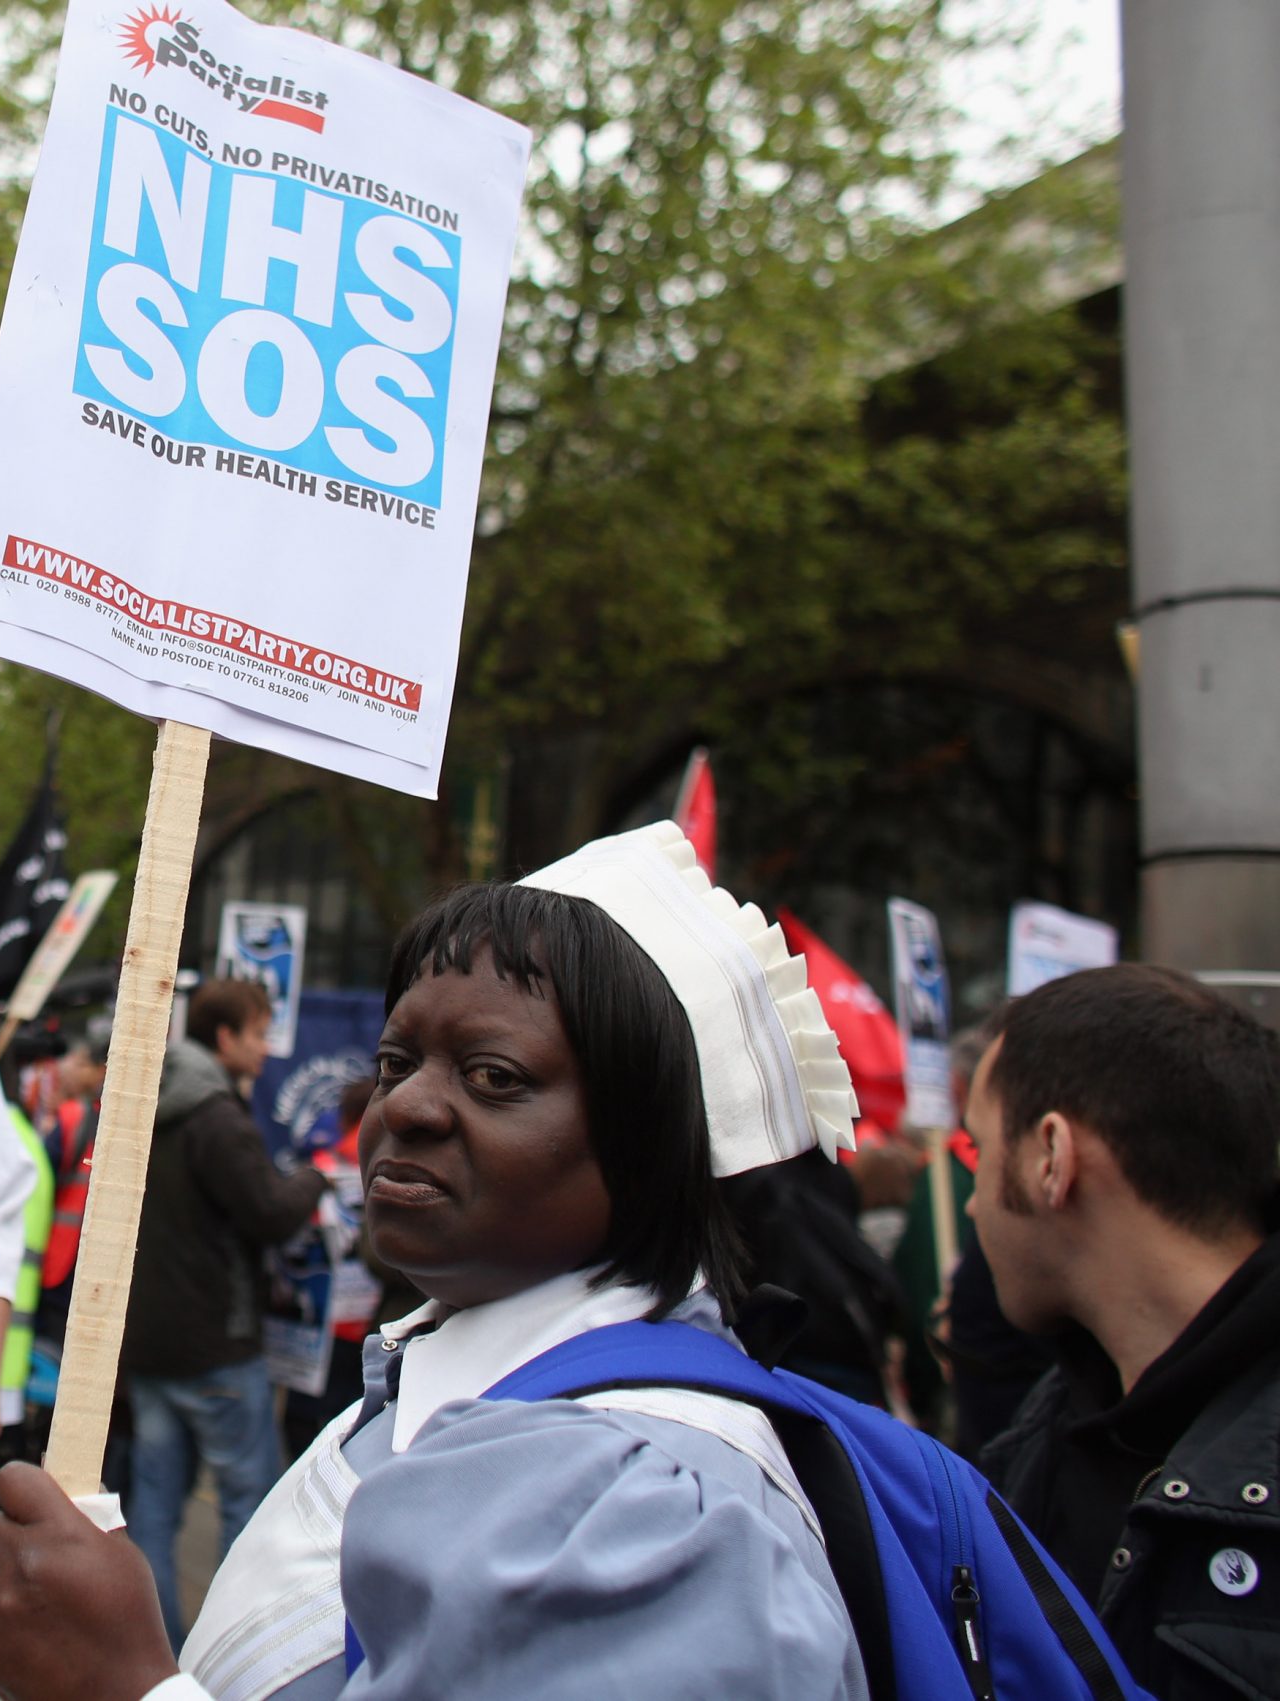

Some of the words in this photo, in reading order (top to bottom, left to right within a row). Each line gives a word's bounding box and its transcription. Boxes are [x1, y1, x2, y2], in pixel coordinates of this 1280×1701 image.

[155, 37, 263, 112] Party
[172, 22, 329, 110] Socialist
[109, 83, 147, 114] NO
[154, 104, 213, 160] CUTS,
[222, 143, 262, 167] NO
[272, 152, 459, 232] PRIVATISATION
[103, 115, 454, 355] NHS
[84, 262, 435, 487] SOS
[81, 402, 147, 449] SAVE
[151, 434, 207, 468] OUR
[215, 449, 318, 497] HEALTH
[324, 480, 436, 530] SERVICE
[0, 568, 30, 586] CALL
[36, 578, 59, 594] 020
[63, 588, 91, 608] 8988
[126, 619, 155, 641] EMAIL
[337, 689, 360, 705] JOIN
[363, 694, 386, 713] AND
[389, 707, 418, 724] YOUR
[15, 541, 409, 704] WWW.SOCIALISTPARTY.ORG.UK
[111, 627, 135, 649] NAME
[136, 642, 159, 657] AND
[161, 644, 214, 671] POSTODE
[217, 663, 231, 676] TO
[233, 670, 266, 689] 07761
[268, 680, 310, 703] 818206
